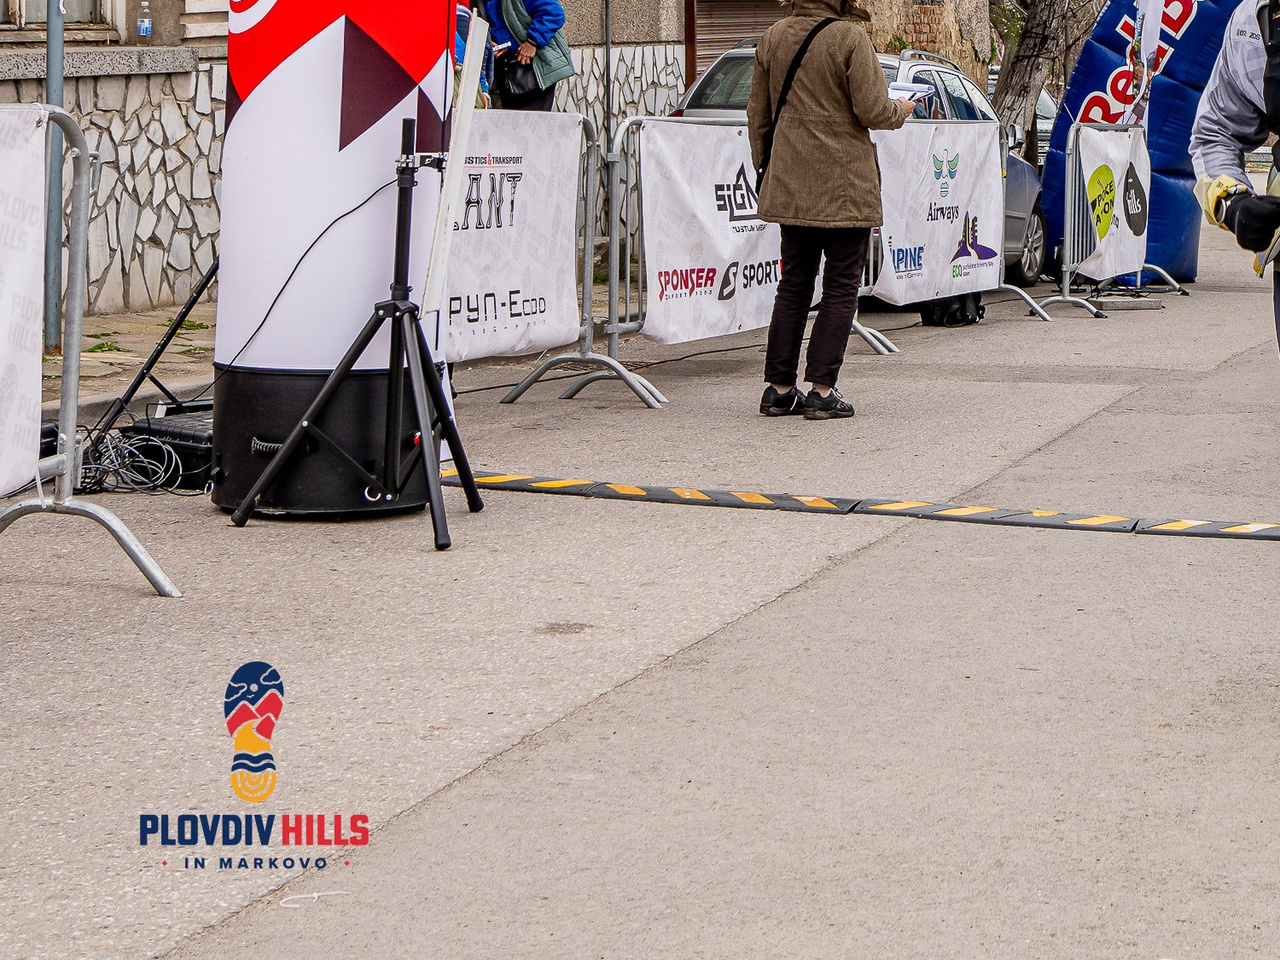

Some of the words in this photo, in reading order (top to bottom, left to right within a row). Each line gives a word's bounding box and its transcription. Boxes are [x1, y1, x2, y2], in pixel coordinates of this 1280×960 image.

[927, 203, 959, 224] Airways
[658, 268, 716, 302] SPONSER
[743, 260, 779, 289] SPORT
